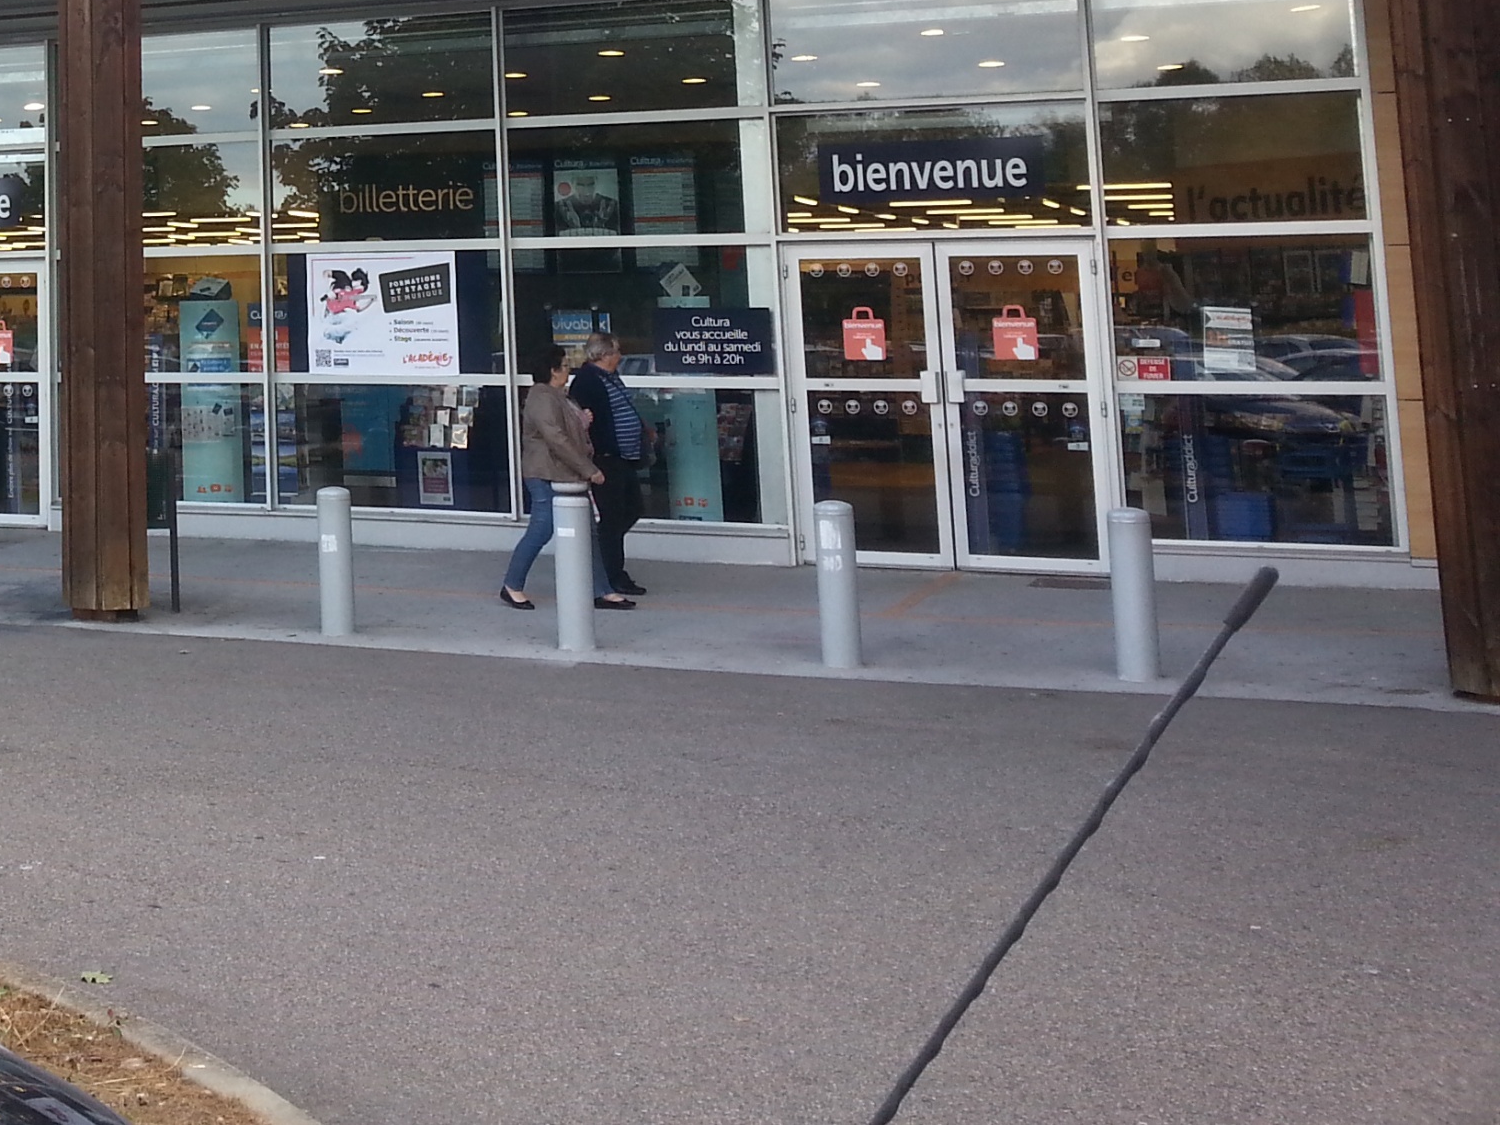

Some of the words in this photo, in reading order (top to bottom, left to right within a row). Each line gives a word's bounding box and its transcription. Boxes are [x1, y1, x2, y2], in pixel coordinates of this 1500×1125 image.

[832, 153, 1028, 192] bienvenue
[340, 181, 474, 213] billetterie
[1187, 174, 1367, 222] l'actualité
[675, 330, 700, 339] vous
[702, 329, 748, 339] accueille
[691, 316, 731, 327] Cultura
[664, 341, 678, 352] du
[680, 340, 706, 352] lundi
[707, 342, 721, 352] au
[723, 341, 762, 352] samedi
[682, 354, 696, 364] de
[698, 353, 712, 365] 9h
[714, 354, 721, 364] à
[722, 353, 745, 365] 20h
[967, 431, 980, 497] Culturaddict
[1183, 434, 1198, 503] Culturaddict
